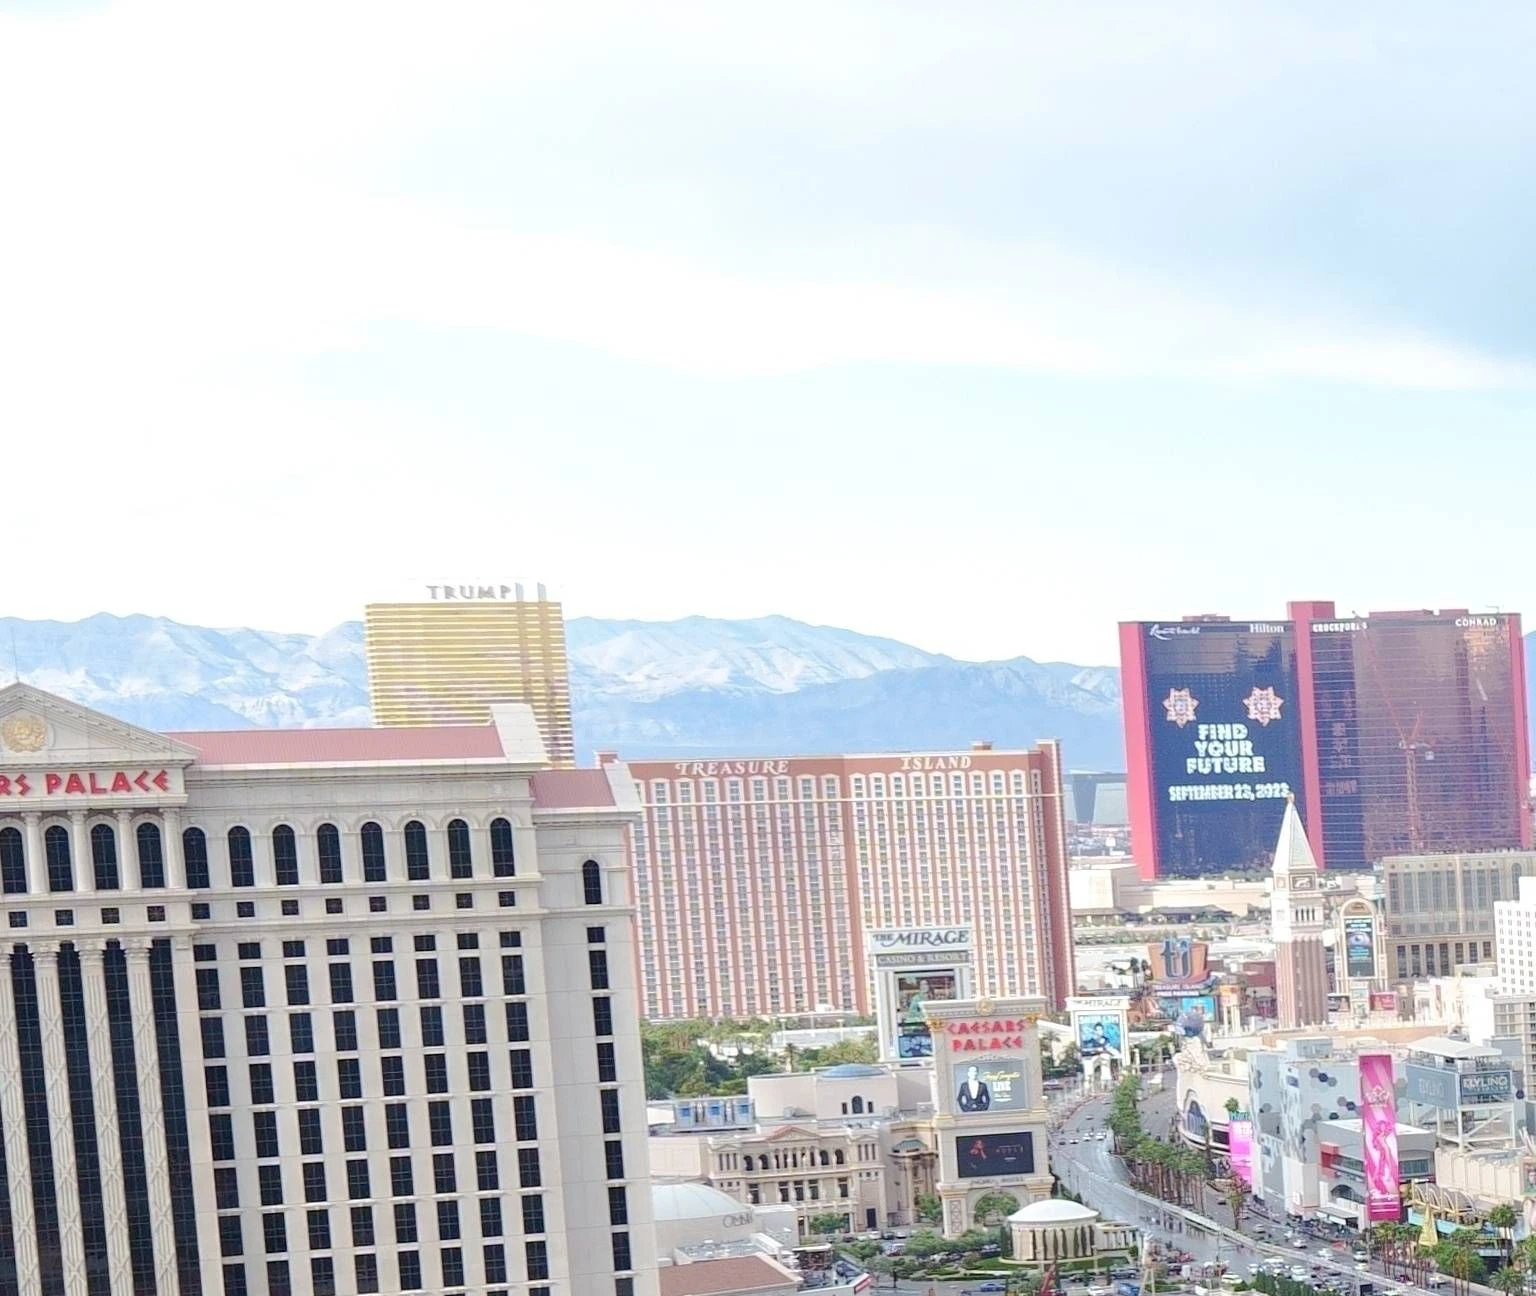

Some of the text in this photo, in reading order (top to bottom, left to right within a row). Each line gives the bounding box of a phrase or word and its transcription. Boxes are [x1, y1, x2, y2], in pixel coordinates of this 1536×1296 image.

[426, 585, 511, 599] TRUMP
[1250, 623, 1284, 634] Hilton
[1455, 617, 1497, 628] CONRAD
[1198, 723, 1249, 740] FIND
[1194, 740, 1254, 757] YOUR
[675, 755, 972, 777] TREASURE ISLAND
[1186, 756, 1266, 774] FUTURE
[45, 769, 169, 796] PALACE
[1168, 784, 1234, 801] SEPTEMBER
[881, 930, 969, 947] MIRAGE
[947, 1020, 1025, 1034] CAESARS
[952, 1036, 1023, 1051] PALACE
